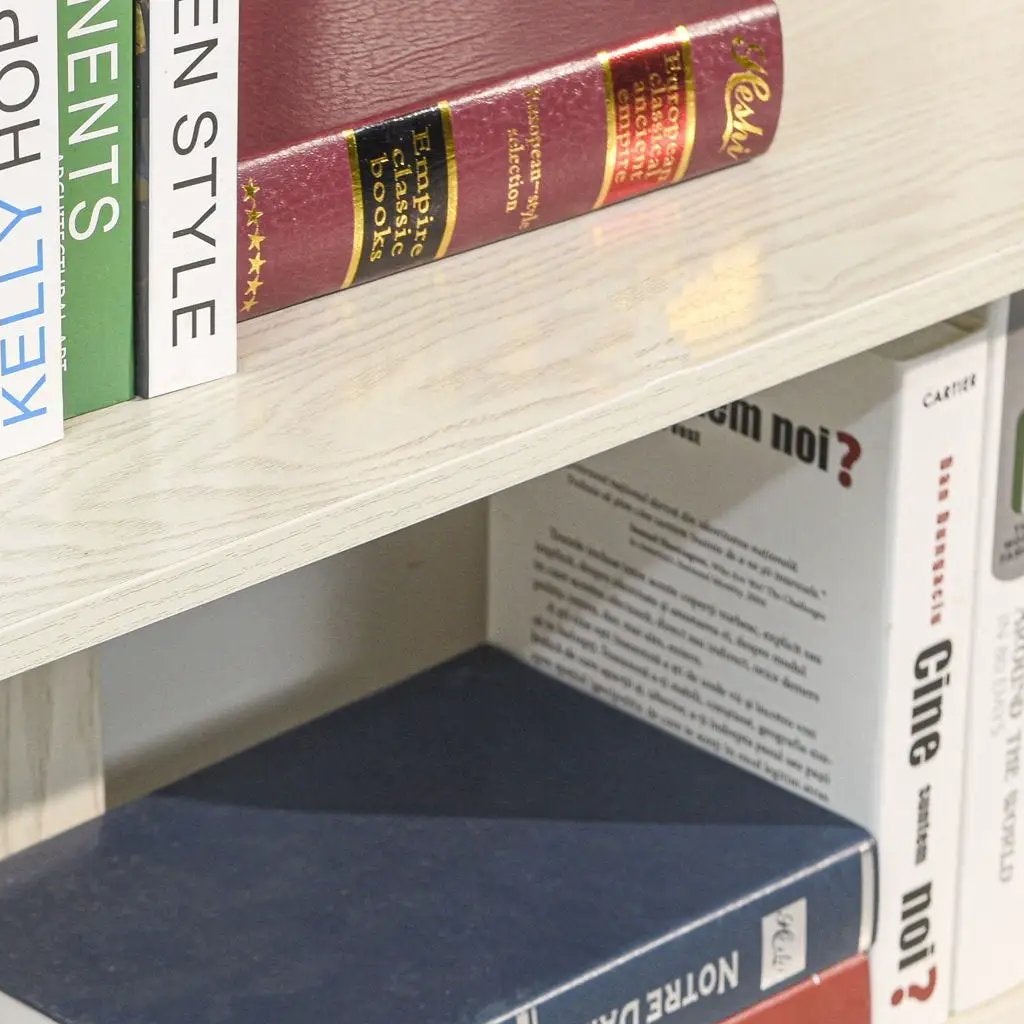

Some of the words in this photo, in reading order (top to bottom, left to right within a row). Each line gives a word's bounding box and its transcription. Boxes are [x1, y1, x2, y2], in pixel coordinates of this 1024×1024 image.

[66, 0, 120, 241] NENTS
[614, 88, 631, 184] empire
[630, 80, 648, 181] ancient
[644, 73, 666, 180] classical
[658, 51, 681, 182] European
[172, 111, 219, 348] STYLE
[369, 152, 392, 262] books
[391, 148, 413, 257] classic
[410, 127, 435, 258] Empire
[922, 373, 976, 409] CARTIER
[772, 413, 862, 488] noi?
[909, 639, 953, 767] Cine
[646, 951, 739, 1024] NOTRE
[892, 881, 937, 1007] noi?
